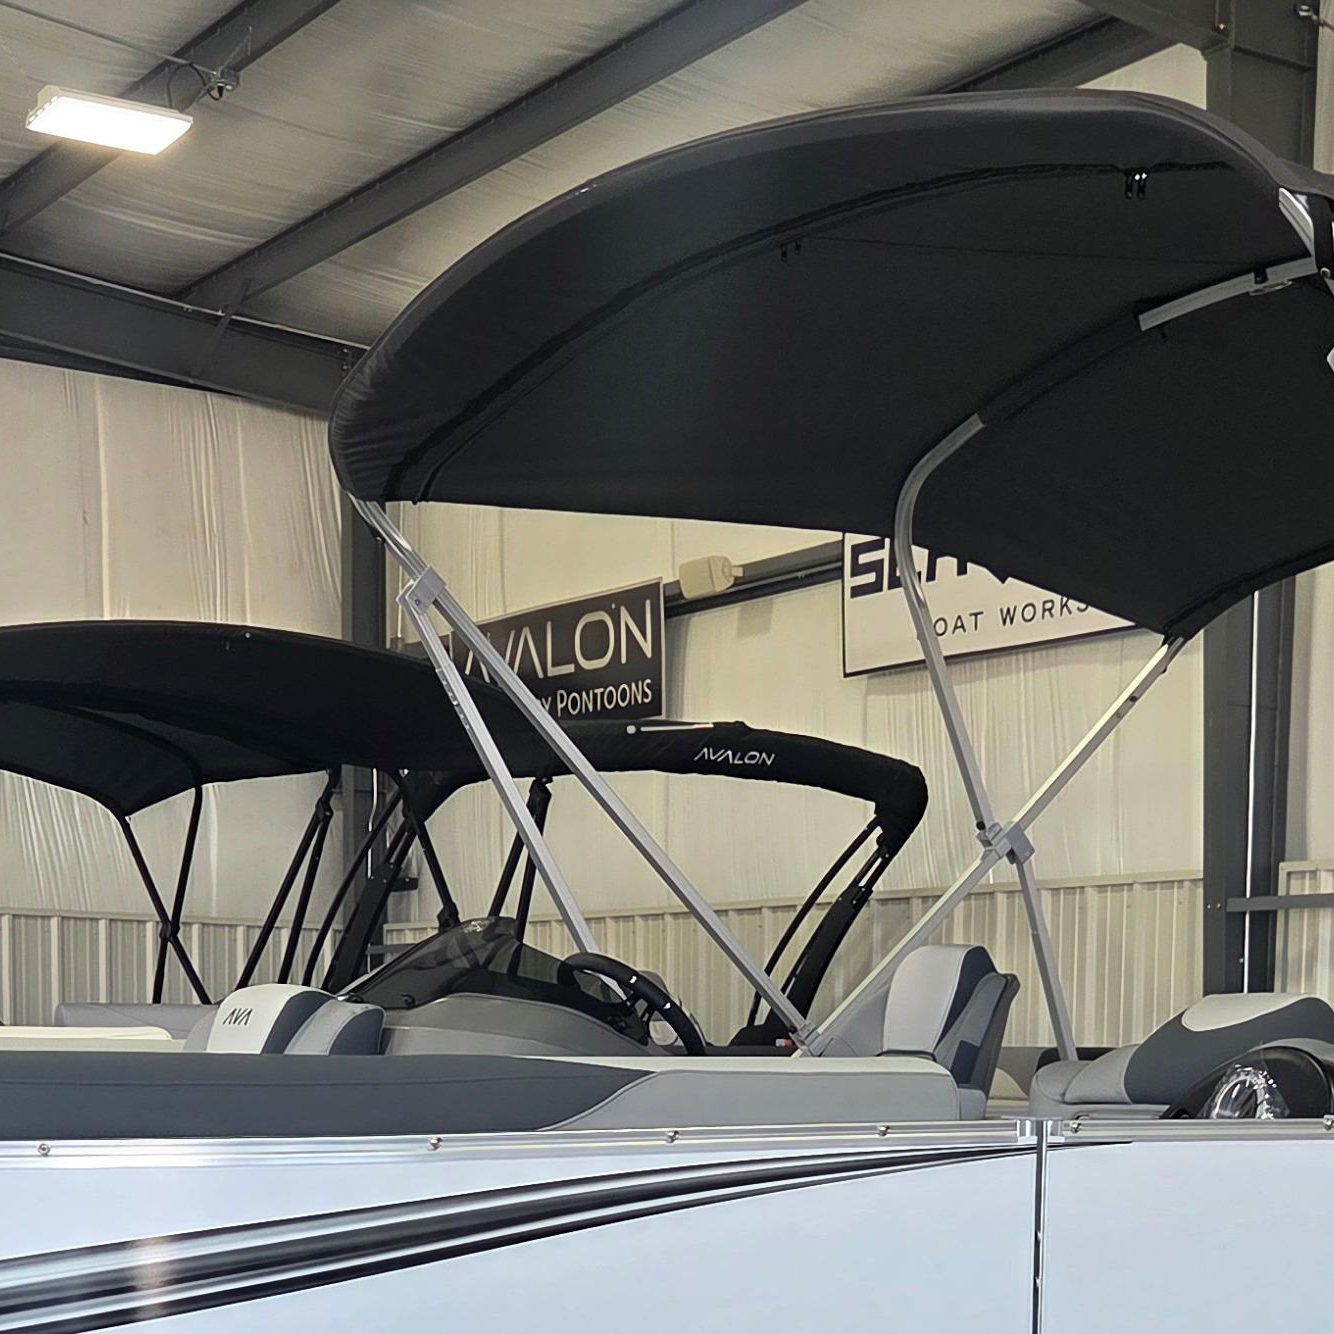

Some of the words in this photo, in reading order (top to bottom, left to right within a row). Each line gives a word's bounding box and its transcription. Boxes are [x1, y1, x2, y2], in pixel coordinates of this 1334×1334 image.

[933, 611, 984, 637] OAT
[557, 678, 652, 718] PONTOONS
[693, 747, 775, 767] AVALON
